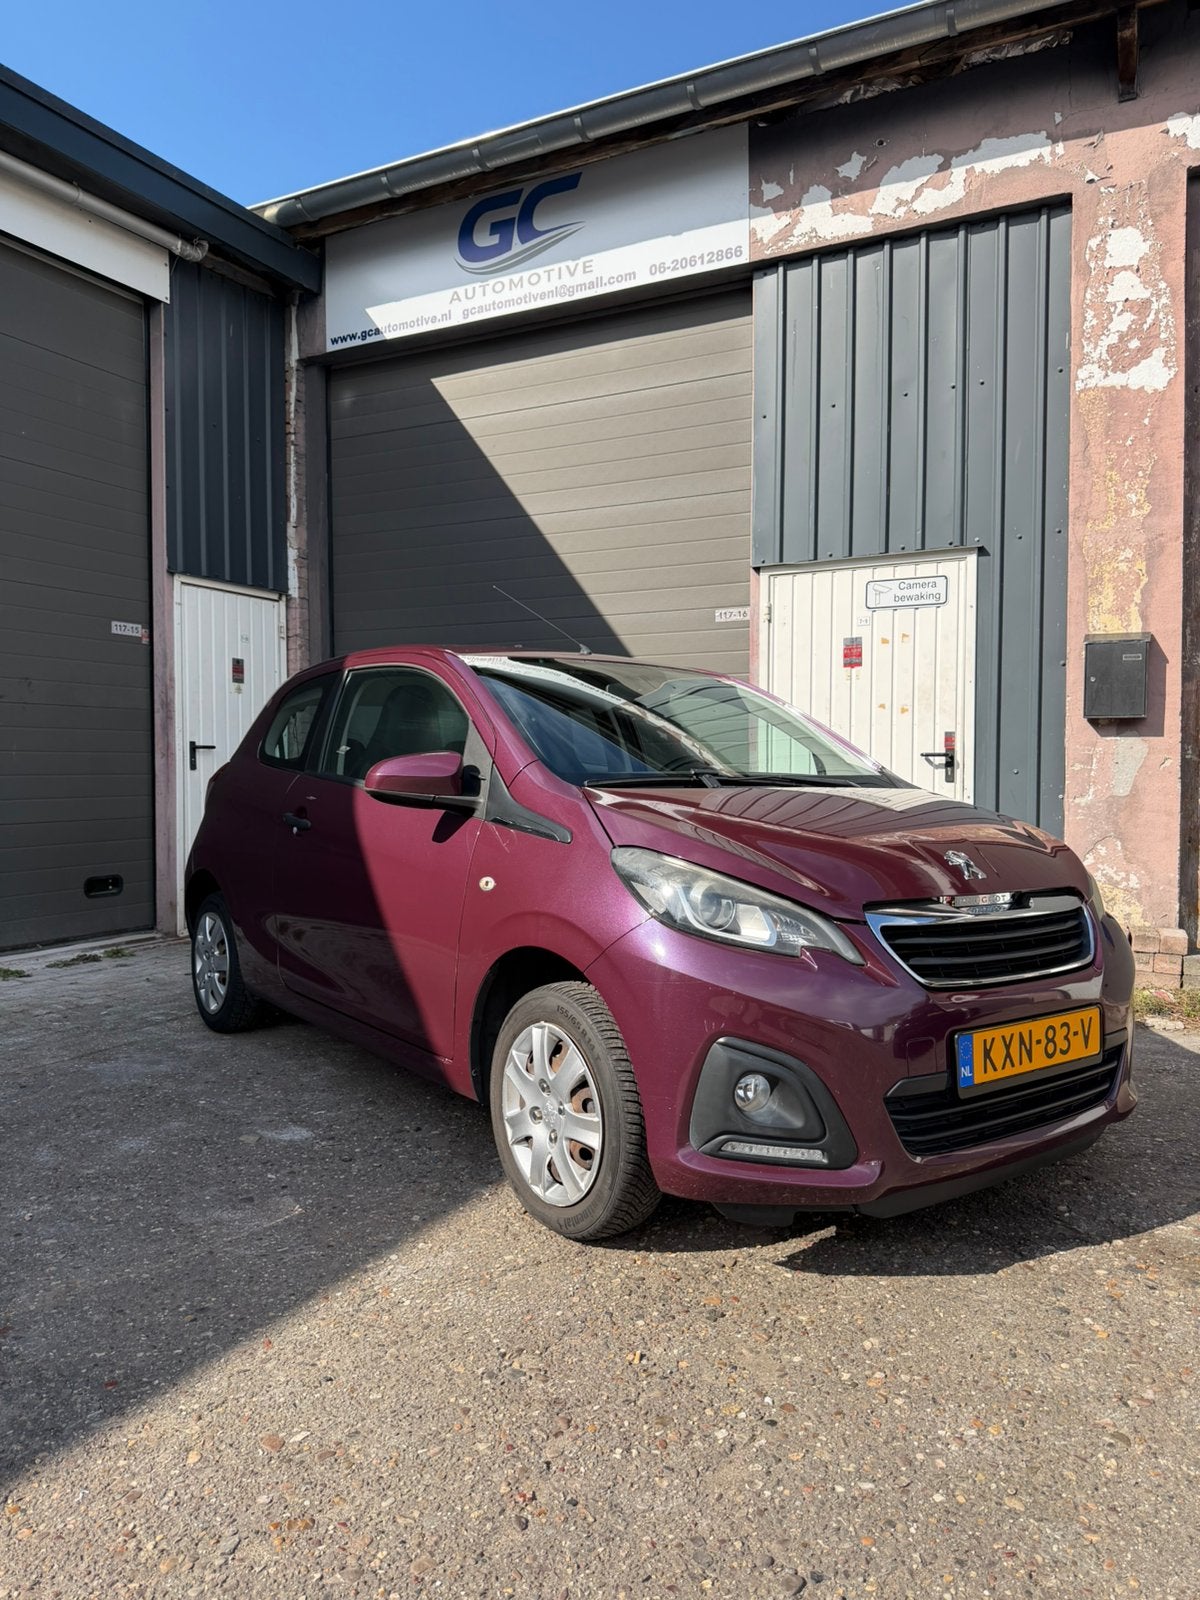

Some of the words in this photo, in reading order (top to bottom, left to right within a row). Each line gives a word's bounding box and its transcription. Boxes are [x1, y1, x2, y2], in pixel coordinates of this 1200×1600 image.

[457, 171, 585, 263] GC
[329, 309, 452, 346] www.gcautomotive.nl
[462, 270, 637, 319] gcautomotivenl@gmail.com
[649, 245, 744, 276] 06-20612866
[449, 259, 594, 304] AUTOMOTIVE
[893, 591, 941, 603] bewaking
[898, 581, 937, 591] Camera
[960, 1065, 973, 1078] NL
[983, 1016, 1093, 1075] KXN-83-V
